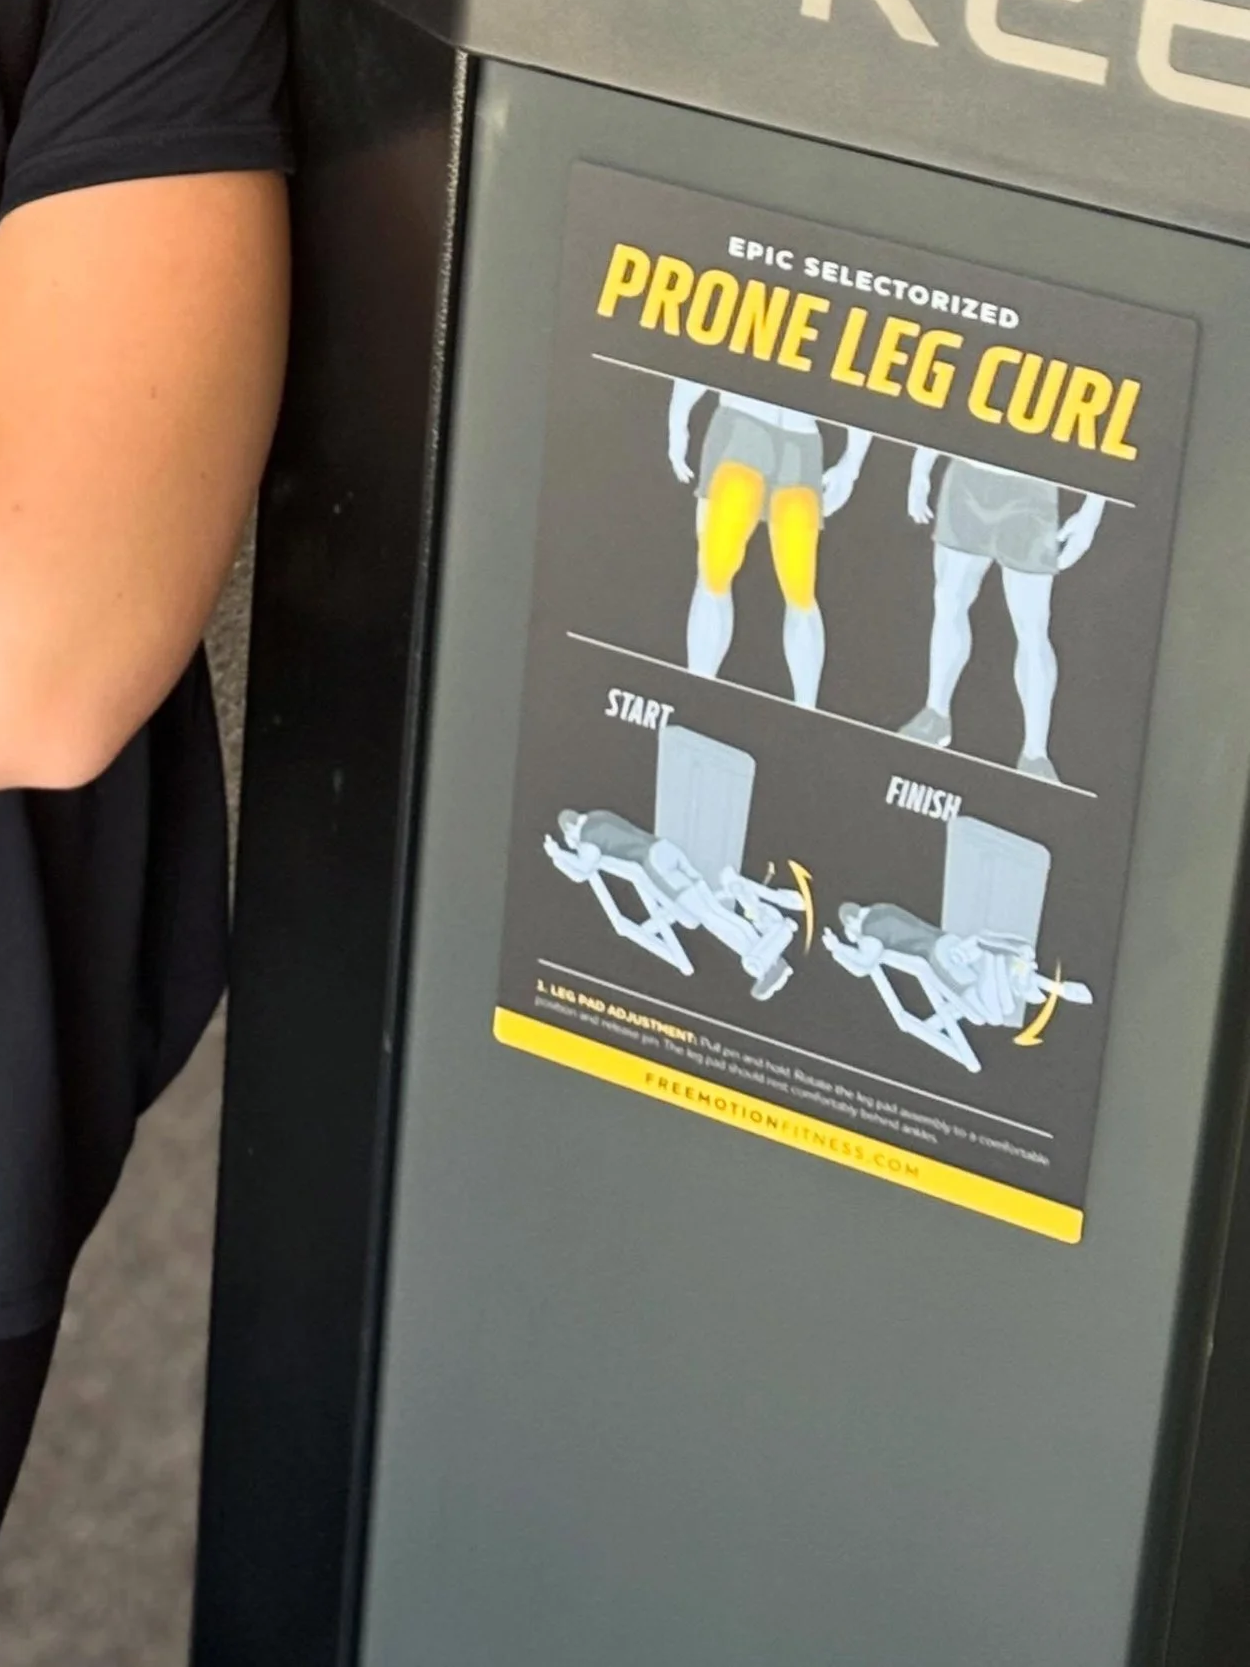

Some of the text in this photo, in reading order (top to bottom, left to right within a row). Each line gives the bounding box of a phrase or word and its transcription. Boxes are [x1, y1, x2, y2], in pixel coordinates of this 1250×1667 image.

[727, 236, 1020, 330] EPIC SELECTORIZED
[596, 242, 1142, 461] PRONE LEG CURL
[604, 687, 675, 730] START
[885, 775, 962, 821] FINISH
[550, 984, 576, 1003] LEG
[578, 993, 606, 1013] PAD
[644, 1071, 920, 1179] FREEMOTIONFITNESS.COM
